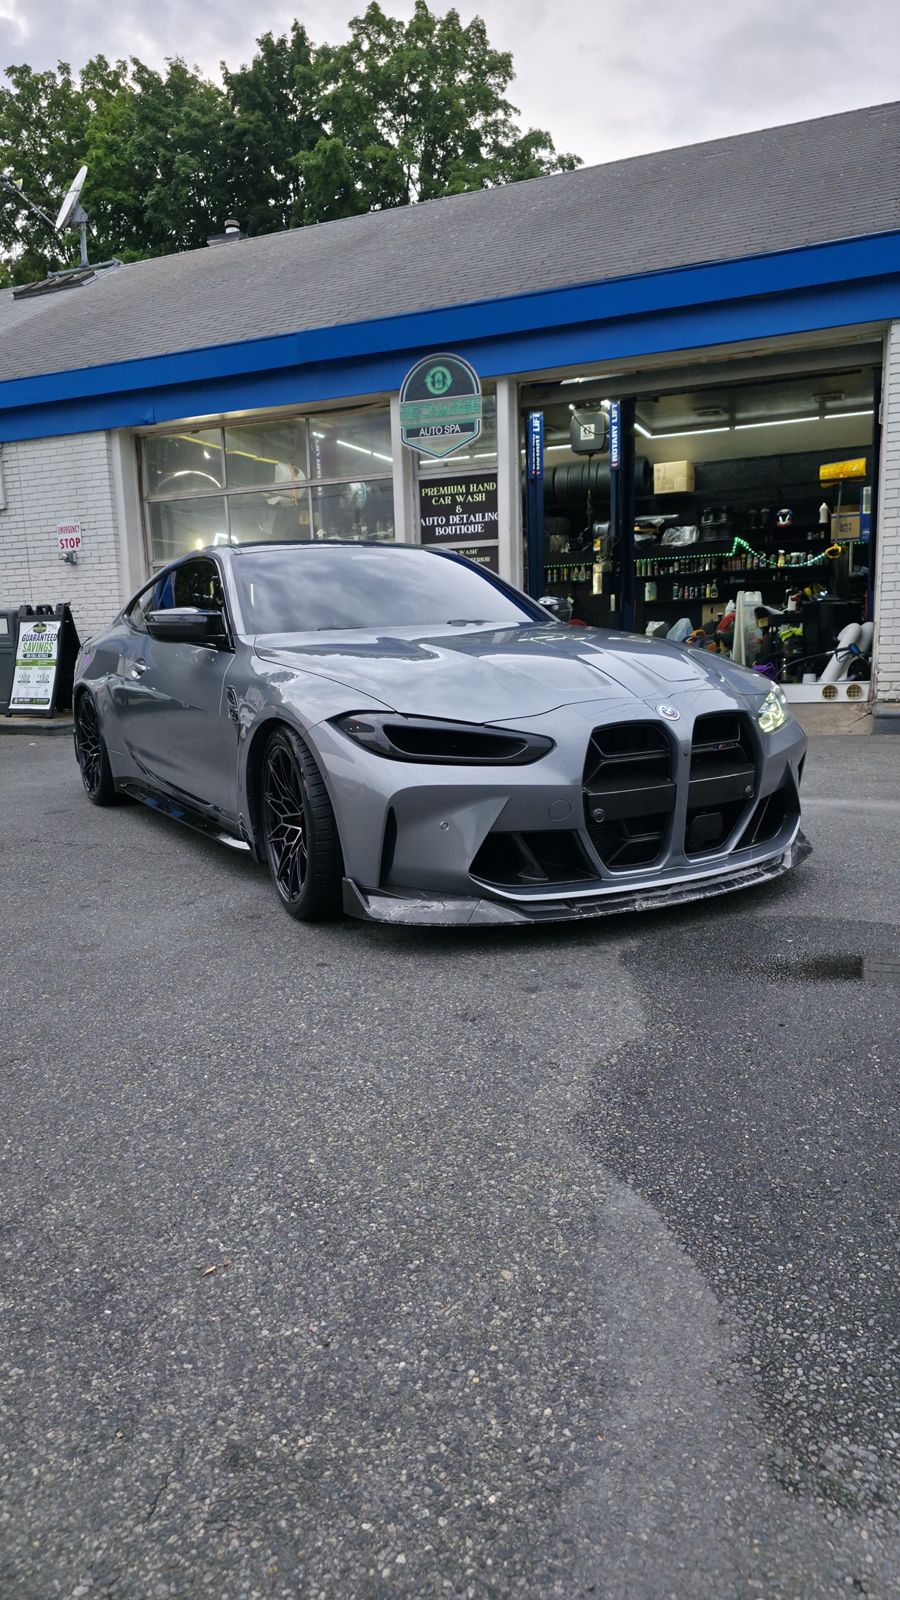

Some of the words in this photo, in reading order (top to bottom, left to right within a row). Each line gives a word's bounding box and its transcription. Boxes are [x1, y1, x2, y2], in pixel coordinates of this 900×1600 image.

[532, 413, 541, 432] LIFT
[419, 427, 443, 437] AUTO
[444, 424, 461, 434] SPA
[421, 484, 466, 497] PREMIUM
[469, 482, 497, 492] HAND
[432, 496, 452, 505] CAR
[455, 493, 486, 503] WASH
[455, 505, 463, 513] &
[435, 524, 485, 536] BOUTIQUE
[60, 537, 81, 549] STOP
[22, 633, 58, 641] GUARANTEED
[22, 641, 54, 653] SAVINGS
